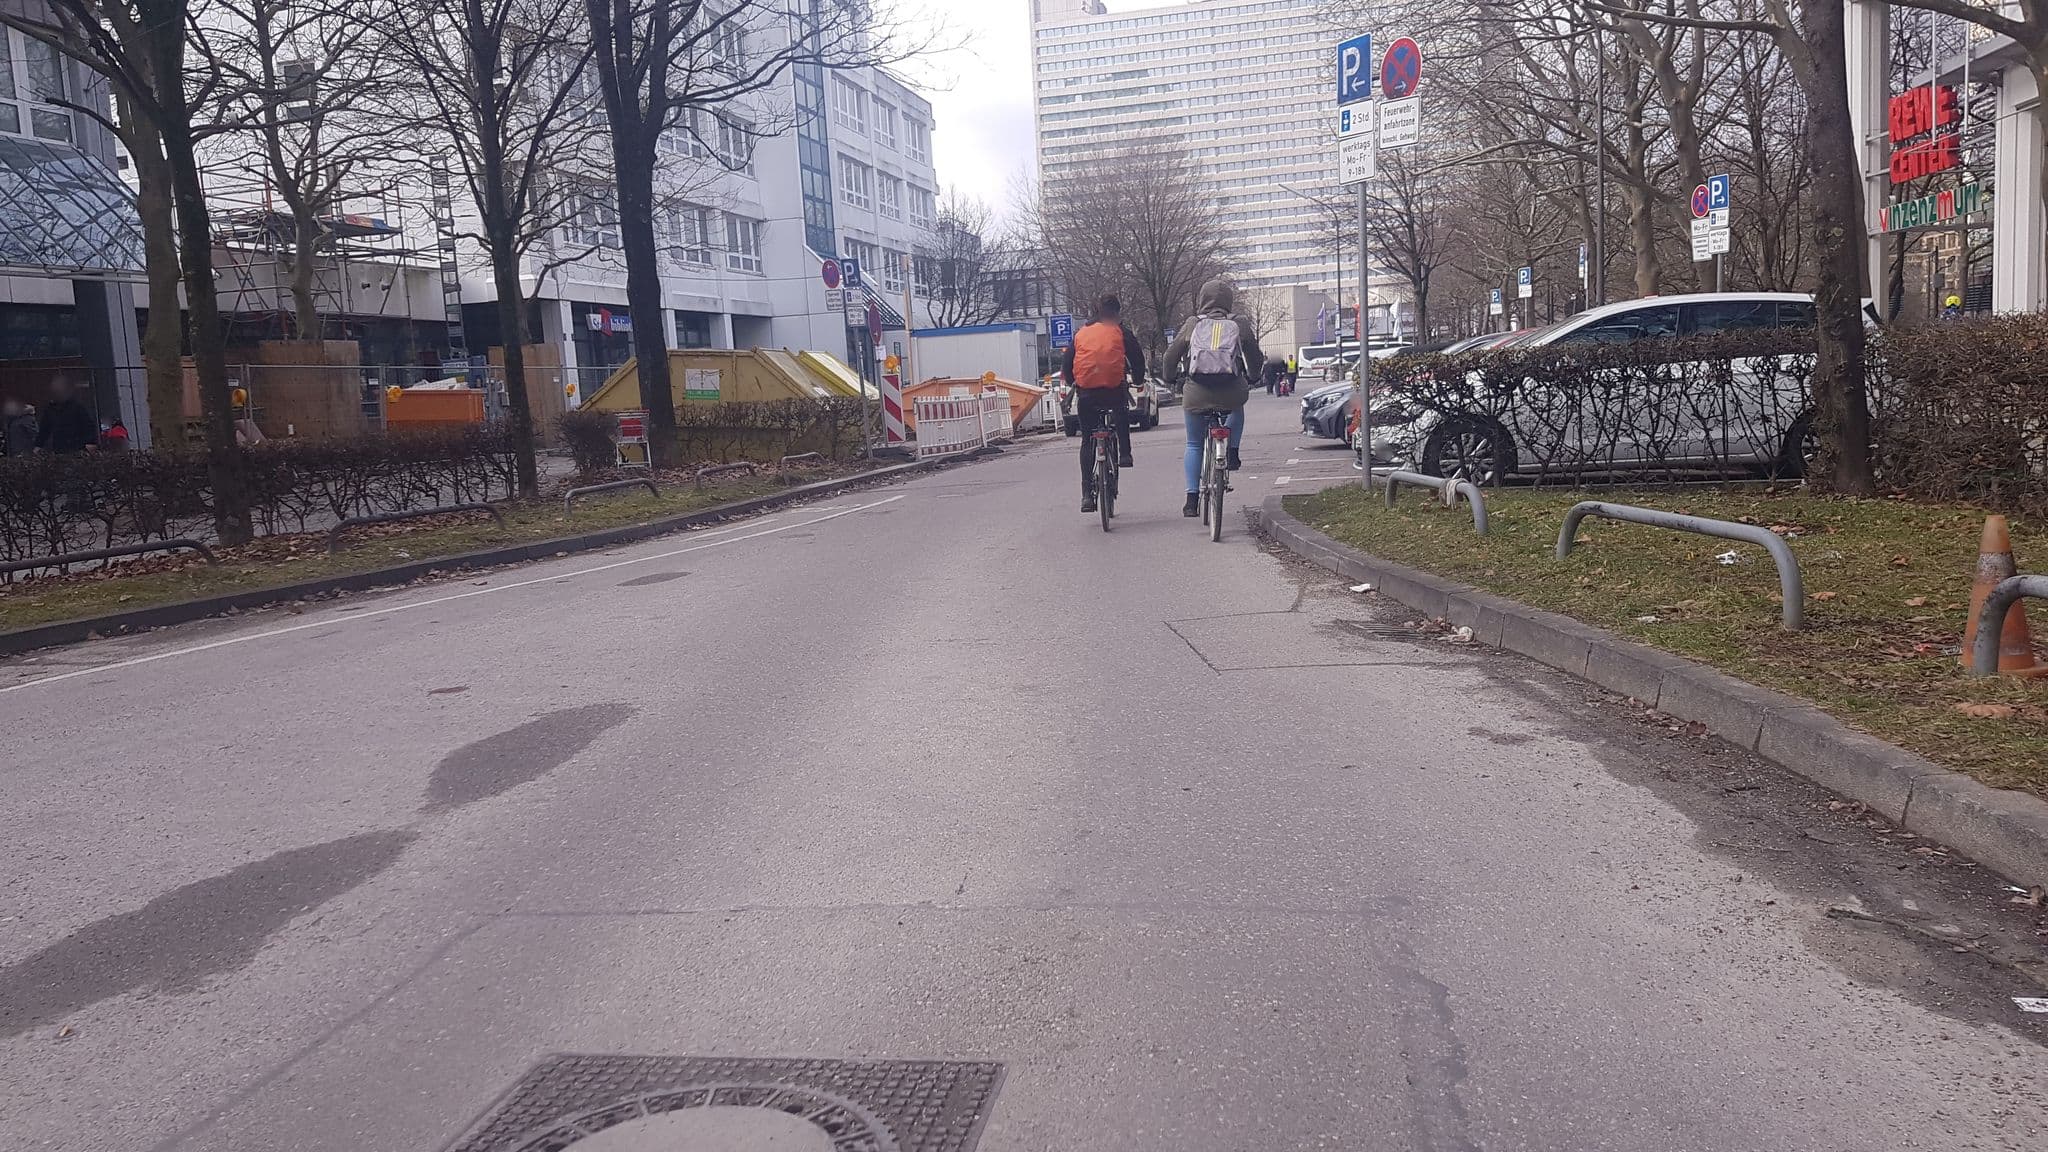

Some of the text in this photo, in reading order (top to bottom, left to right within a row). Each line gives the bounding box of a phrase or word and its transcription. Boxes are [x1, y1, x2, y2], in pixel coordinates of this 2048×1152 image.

[1342, 46, 1360, 96] P
[1352, 114, 1356, 125] 2
[1888, 85, 1954, 143] REWE
[1343, 140, 1371, 153] werktags
[1890, 134, 1953, 184] CENTER
[1712, 180, 1722, 206] P
[843, 262, 854, 285] P
[1520, 270, 1528, 283] P
[1492, 291, 1498, 302] P
[1057, 323, 1066, 335] P
